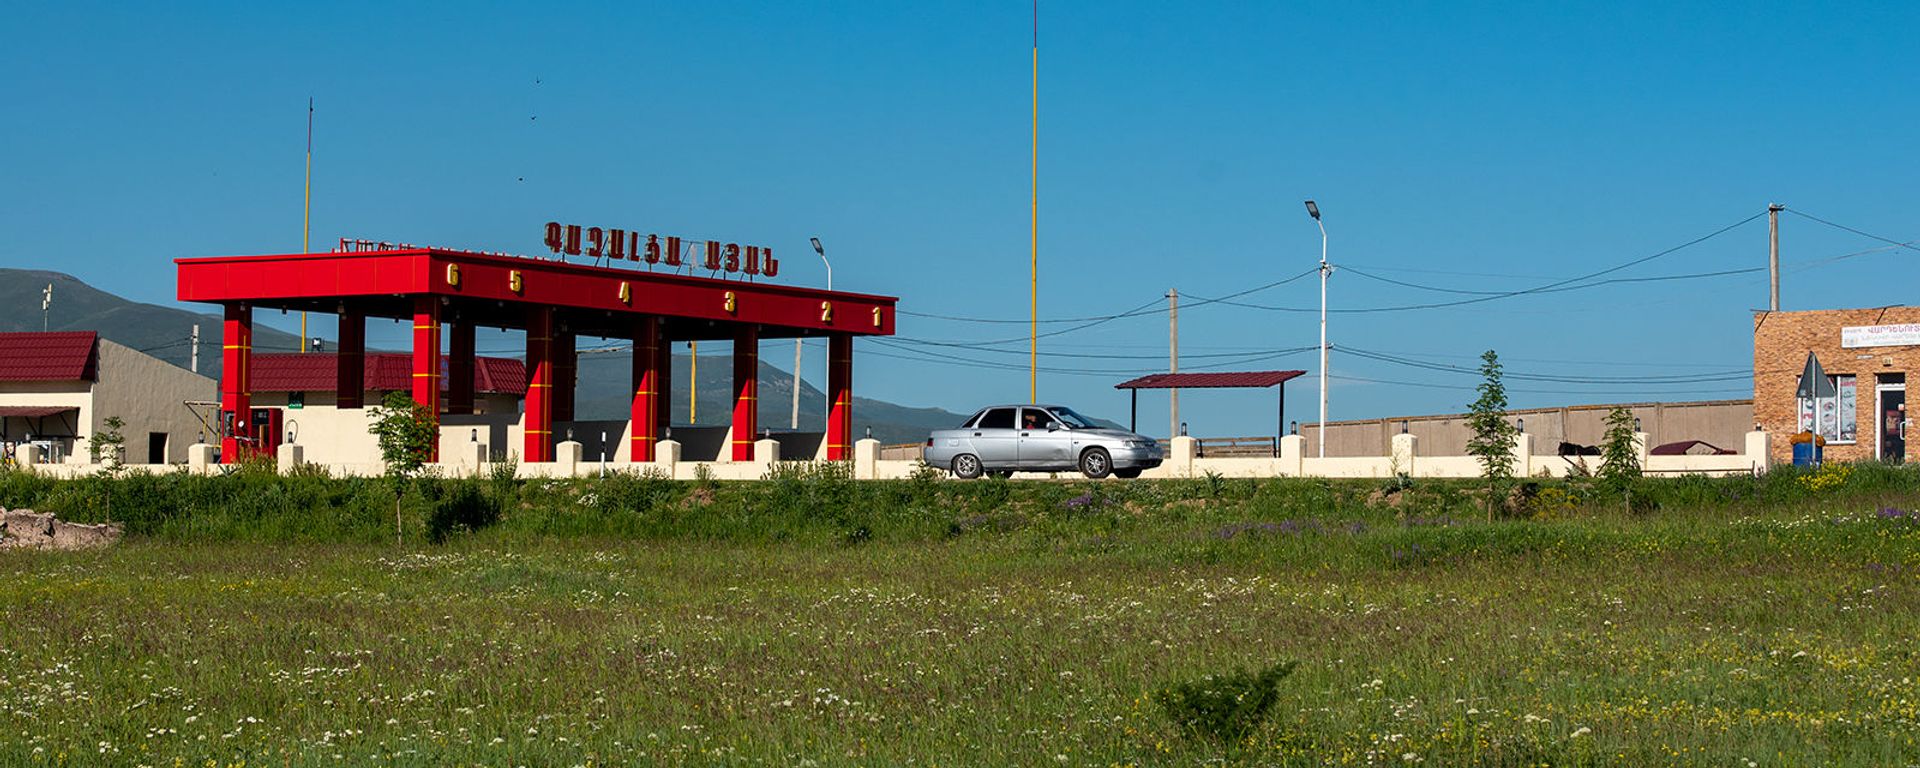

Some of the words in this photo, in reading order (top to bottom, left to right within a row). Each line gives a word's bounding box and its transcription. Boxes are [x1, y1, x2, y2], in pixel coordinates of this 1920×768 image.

[447, 263, 459, 286] 6
[510, 269, 521, 292] 5
[619, 281, 630, 303] 4
[724, 291, 735, 312] 3
[821, 301, 831, 321] 2
[873, 306, 881, 326] 1
